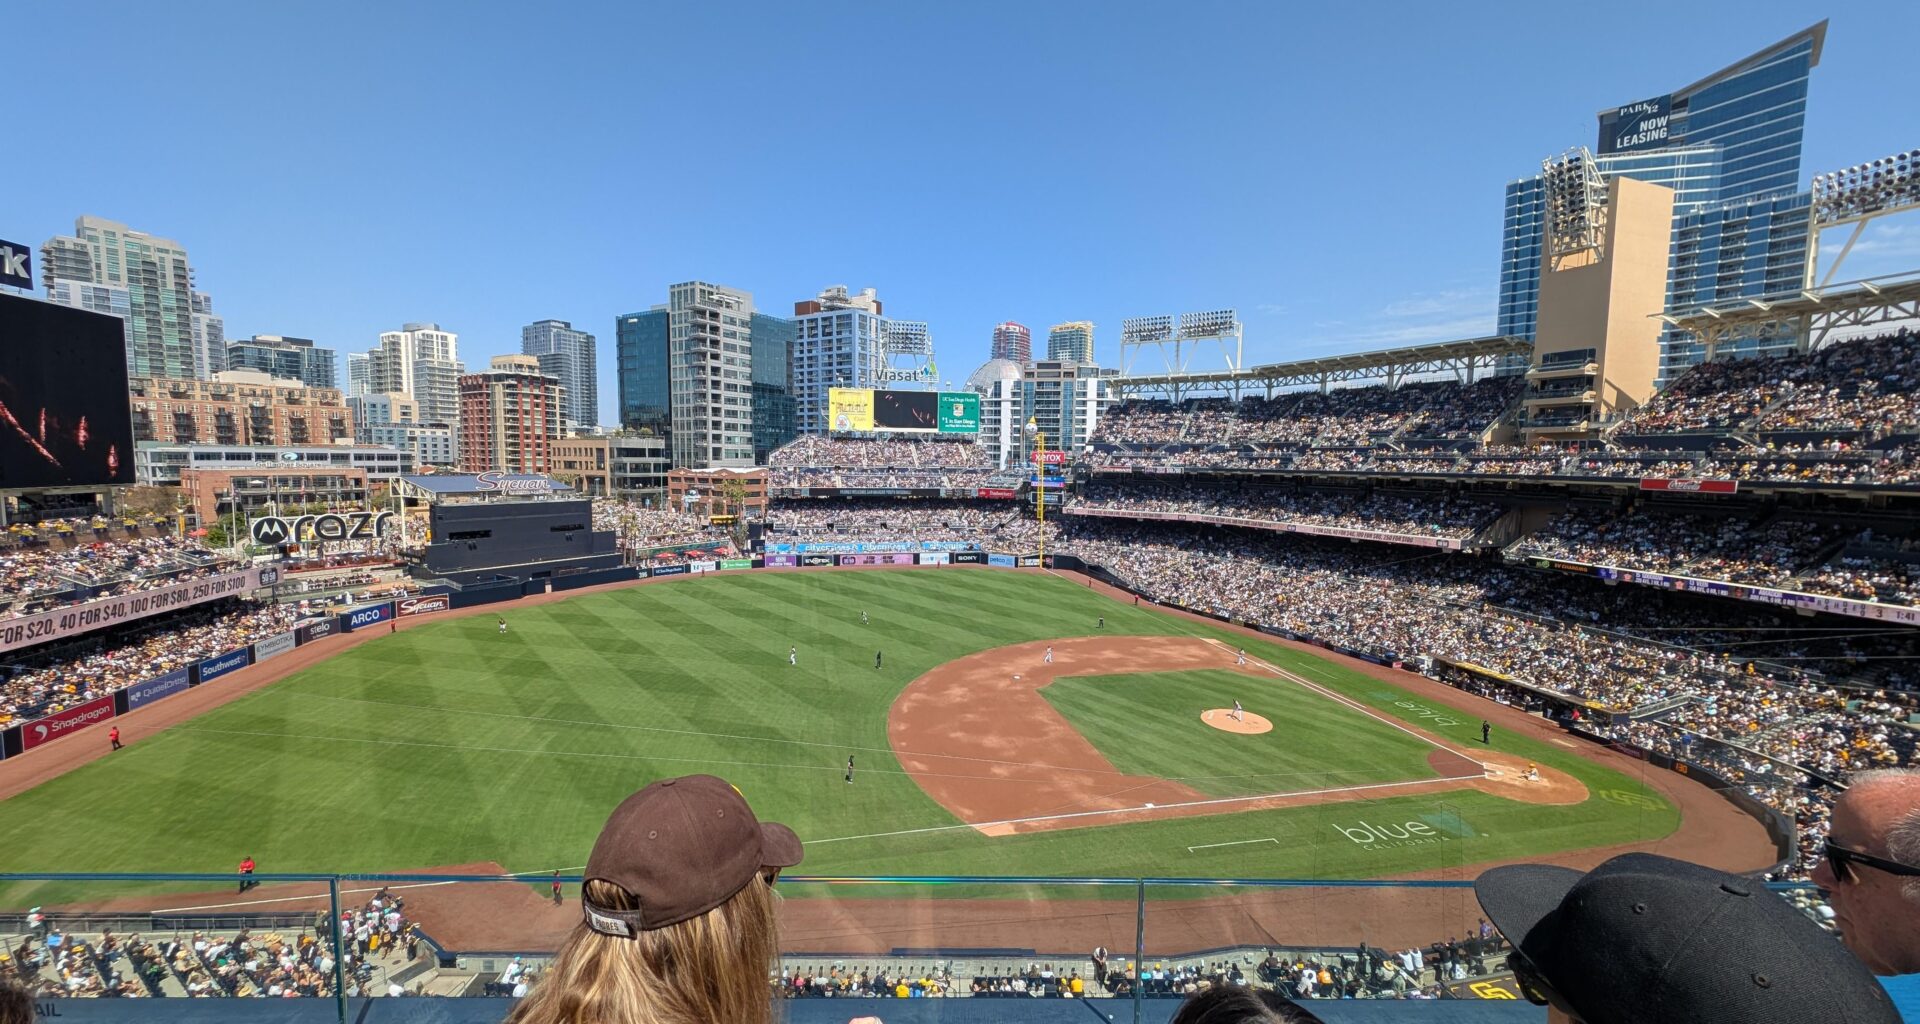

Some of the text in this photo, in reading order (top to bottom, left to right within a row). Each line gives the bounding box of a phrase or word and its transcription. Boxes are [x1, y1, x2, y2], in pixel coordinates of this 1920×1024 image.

[1620, 102, 1649, 116] PARK
[1640, 115, 1669, 132] NOW
[1616, 127, 1668, 149] LEASING
[875, 369, 919, 382] Viasat
[1035, 453, 1062, 461] xerox
[475, 470, 551, 496] Sycuan
[26, 618, 56, 639] $20,
[60, 613, 76, 630] 40
[79, 608, 101, 625] FOR
[103, 602, 127, 621] $40,
[130, 597, 148, 614] 100
[150, 595, 168, 609] FOR
[170, 588, 191, 604] $80,
[193, 584, 210, 599] 250
[211, 580, 226, 595] FOR
[227, 576, 246, 592] $100
[401, 600, 444, 613] Sycuan
[351, 609, 380, 625] ARCO
[1876, 609, 1883, 618] 3
[1896, 611, 1915, 621] 1:41
[310, 622, 331, 635] stelo
[203, 656, 241, 677] Southwest
[52, 704, 110, 732] Snapdragon
[1332, 821, 1436, 844] blue
[1363, 836, 1450, 851] CALIFORNIA
[34, 1003, 62, 1017] AIL
